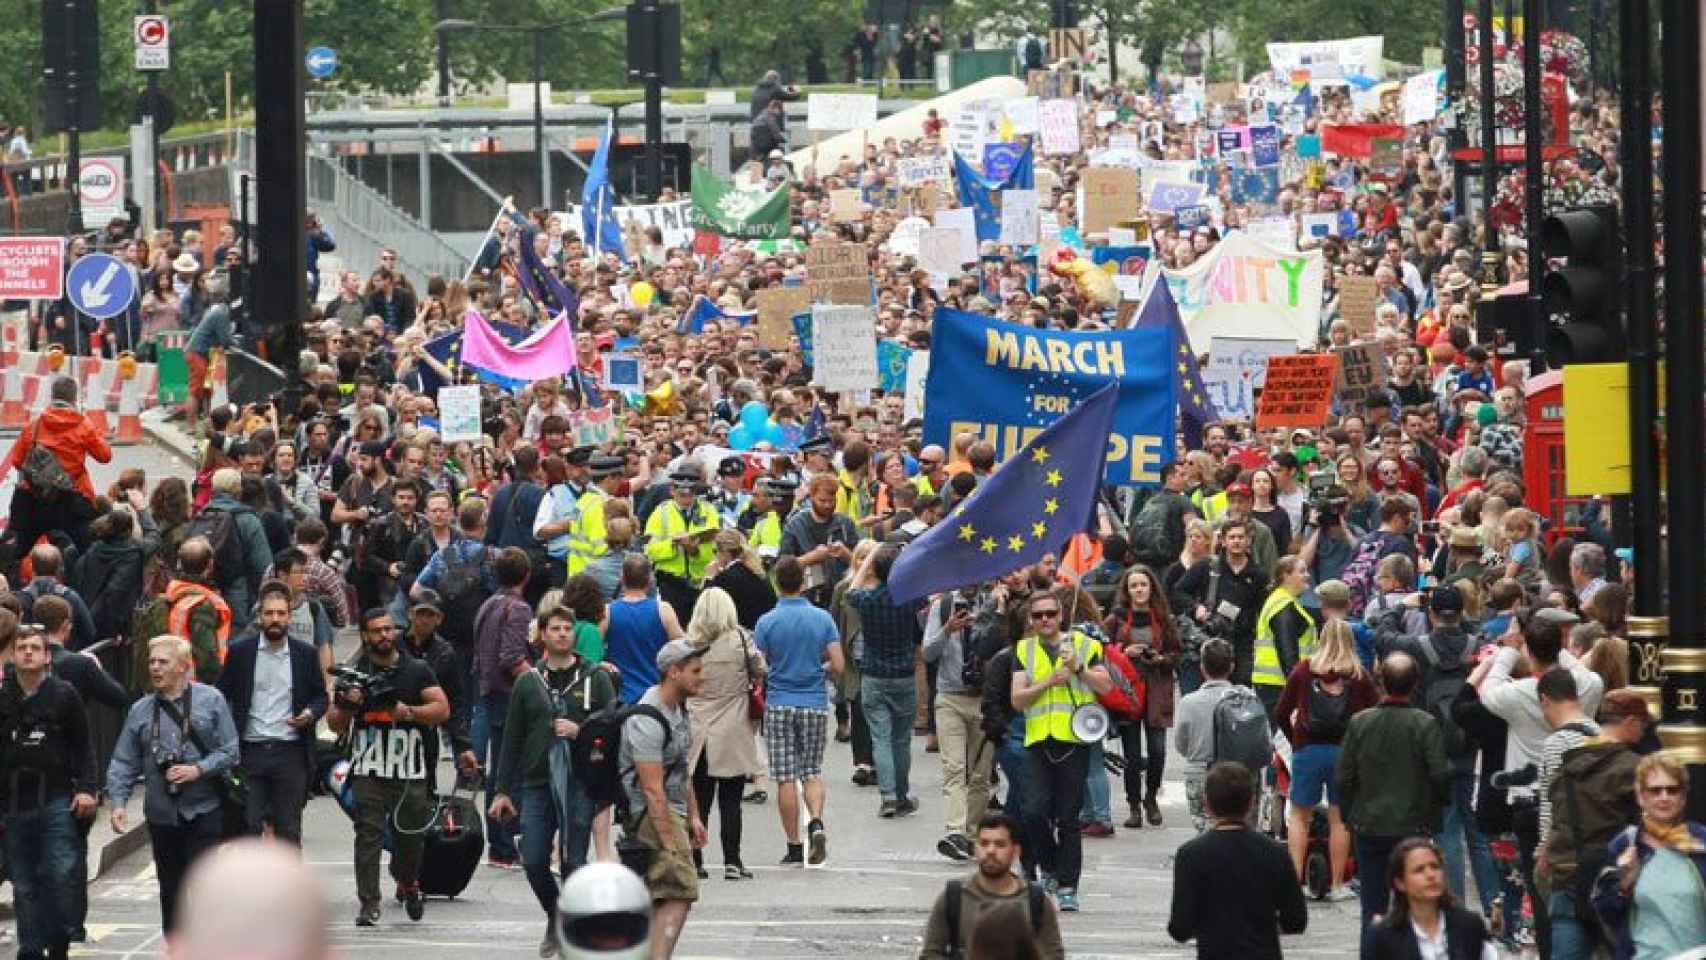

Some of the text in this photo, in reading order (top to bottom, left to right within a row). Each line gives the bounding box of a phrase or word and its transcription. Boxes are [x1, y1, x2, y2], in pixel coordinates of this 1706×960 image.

[1055, 31, 1084, 58] IN
[0, 279, 48, 289] NNELS
[985, 328, 1126, 377] MARCH
[1033, 394, 1070, 414] FOR
[949, 420, 1162, 483] EUPE
